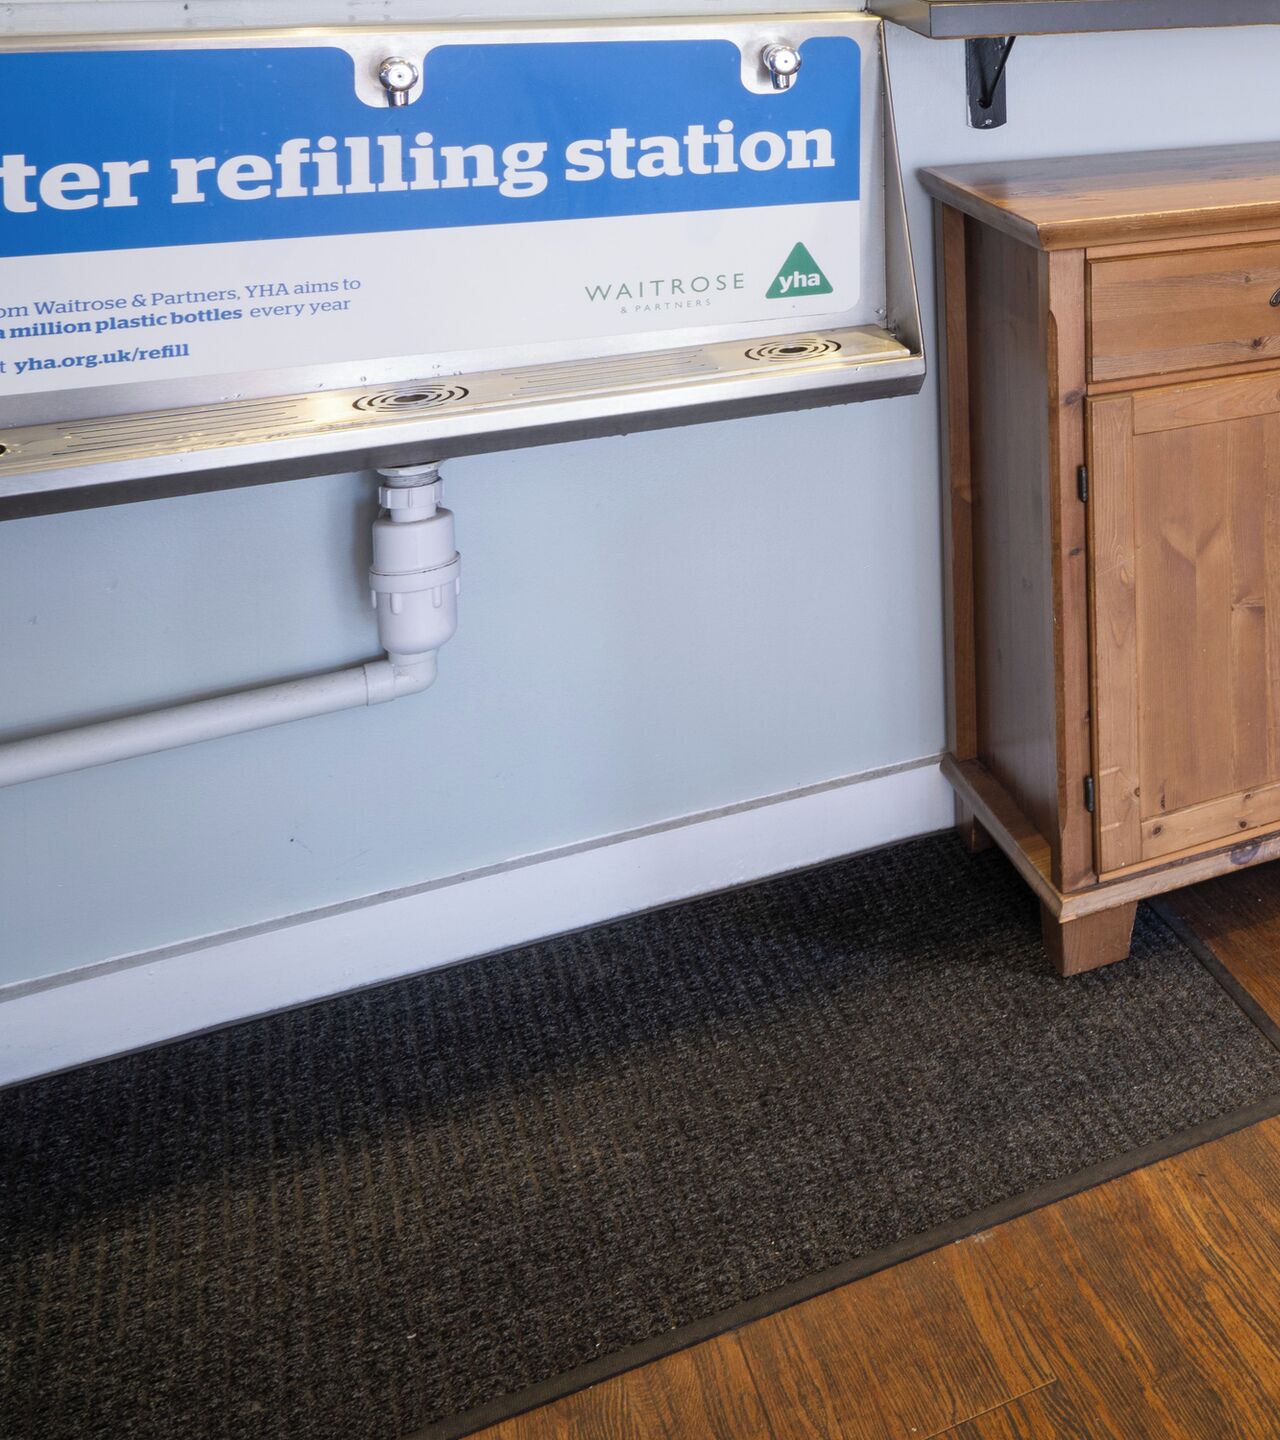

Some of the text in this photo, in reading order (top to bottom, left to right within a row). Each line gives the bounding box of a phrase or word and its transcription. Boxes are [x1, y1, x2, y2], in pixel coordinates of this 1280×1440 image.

[171, 131, 548, 204] refilling
[565, 119, 835, 182] station
[34, 295, 127, 315] Waitrose
[131, 293, 147, 307] &
[151, 287, 241, 306] Partners,
[245, 282, 289, 299] YHA
[294, 278, 339, 294] aims
[343, 278, 361, 291] to
[585, 273, 745, 301] WAITROSE
[779, 270, 821, 293] yha
[10, 319, 92, 338] million
[96, 312, 167, 335] plastic
[171, 307, 243, 326] bottles
[249, 302, 305, 319] every
[309, 298, 351, 316] year
[620, 298, 711, 314] & PARTNERS
[14, 343, 190, 375] yha.org.uk/refill
